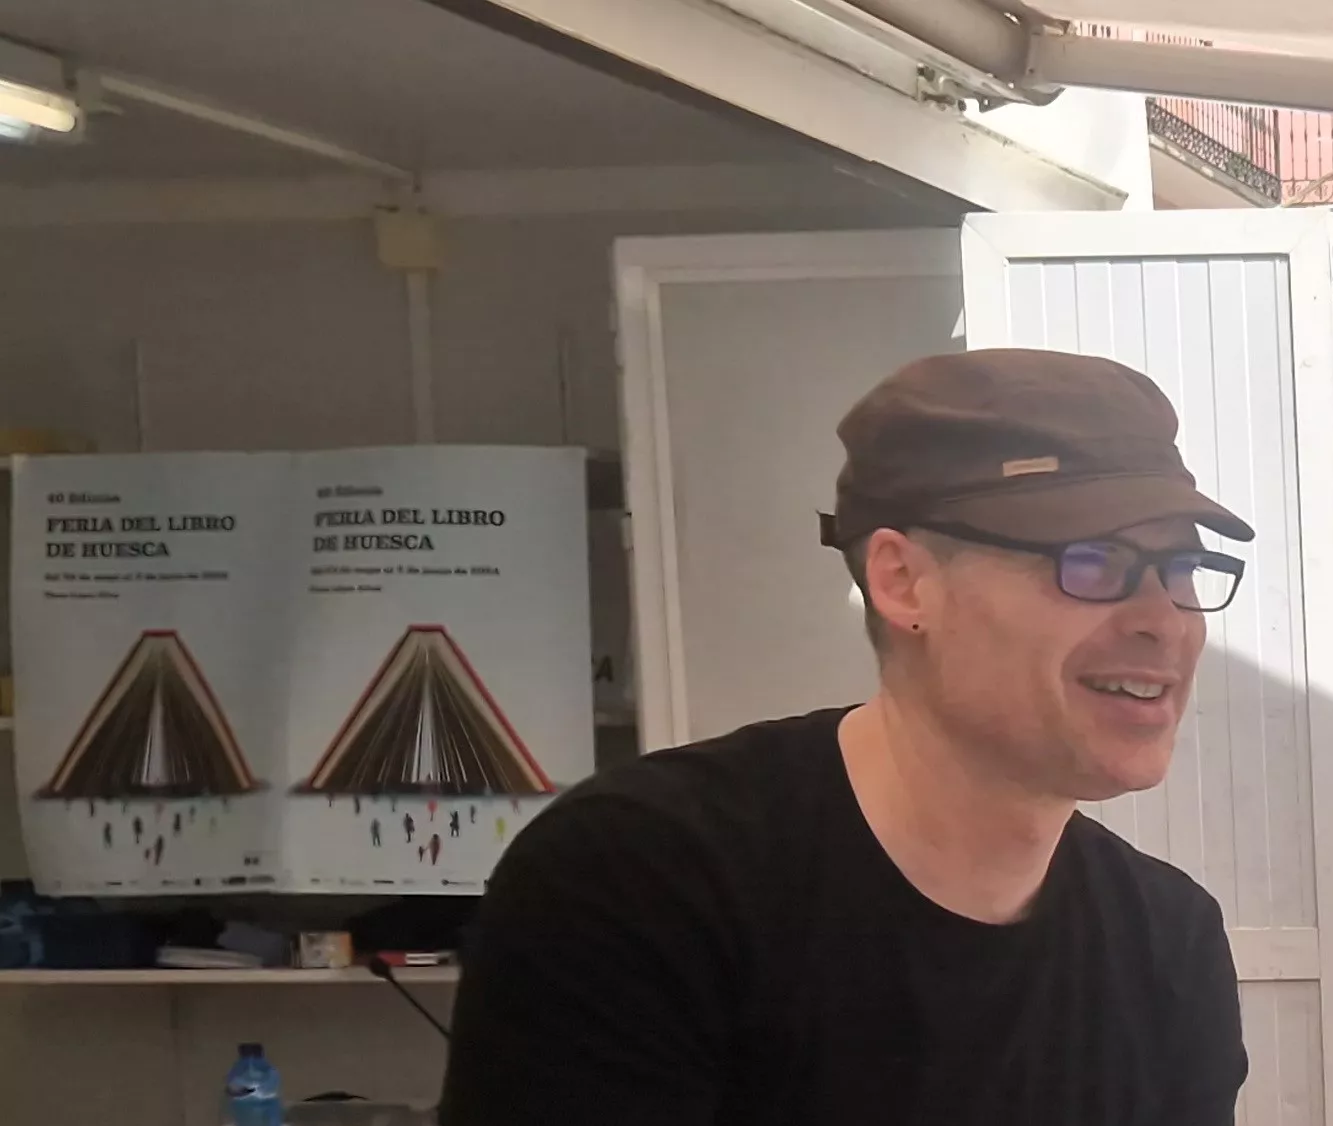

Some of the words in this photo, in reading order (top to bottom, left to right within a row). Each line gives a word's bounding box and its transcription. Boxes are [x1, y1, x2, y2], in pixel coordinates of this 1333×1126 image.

[47, 518, 113, 533] FERIA
[121, 517, 161, 531] DEL
[168, 516, 236, 531] LIBRO
[315, 510, 376, 527] FERIA
[381, 509, 425, 525] DEL
[431, 510, 505, 526] LIBRO
[46, 542, 75, 558] DE
[81, 542, 170, 557] HUESCA
[313, 536, 337, 551] DE
[343, 534, 435, 551] HUESCA
